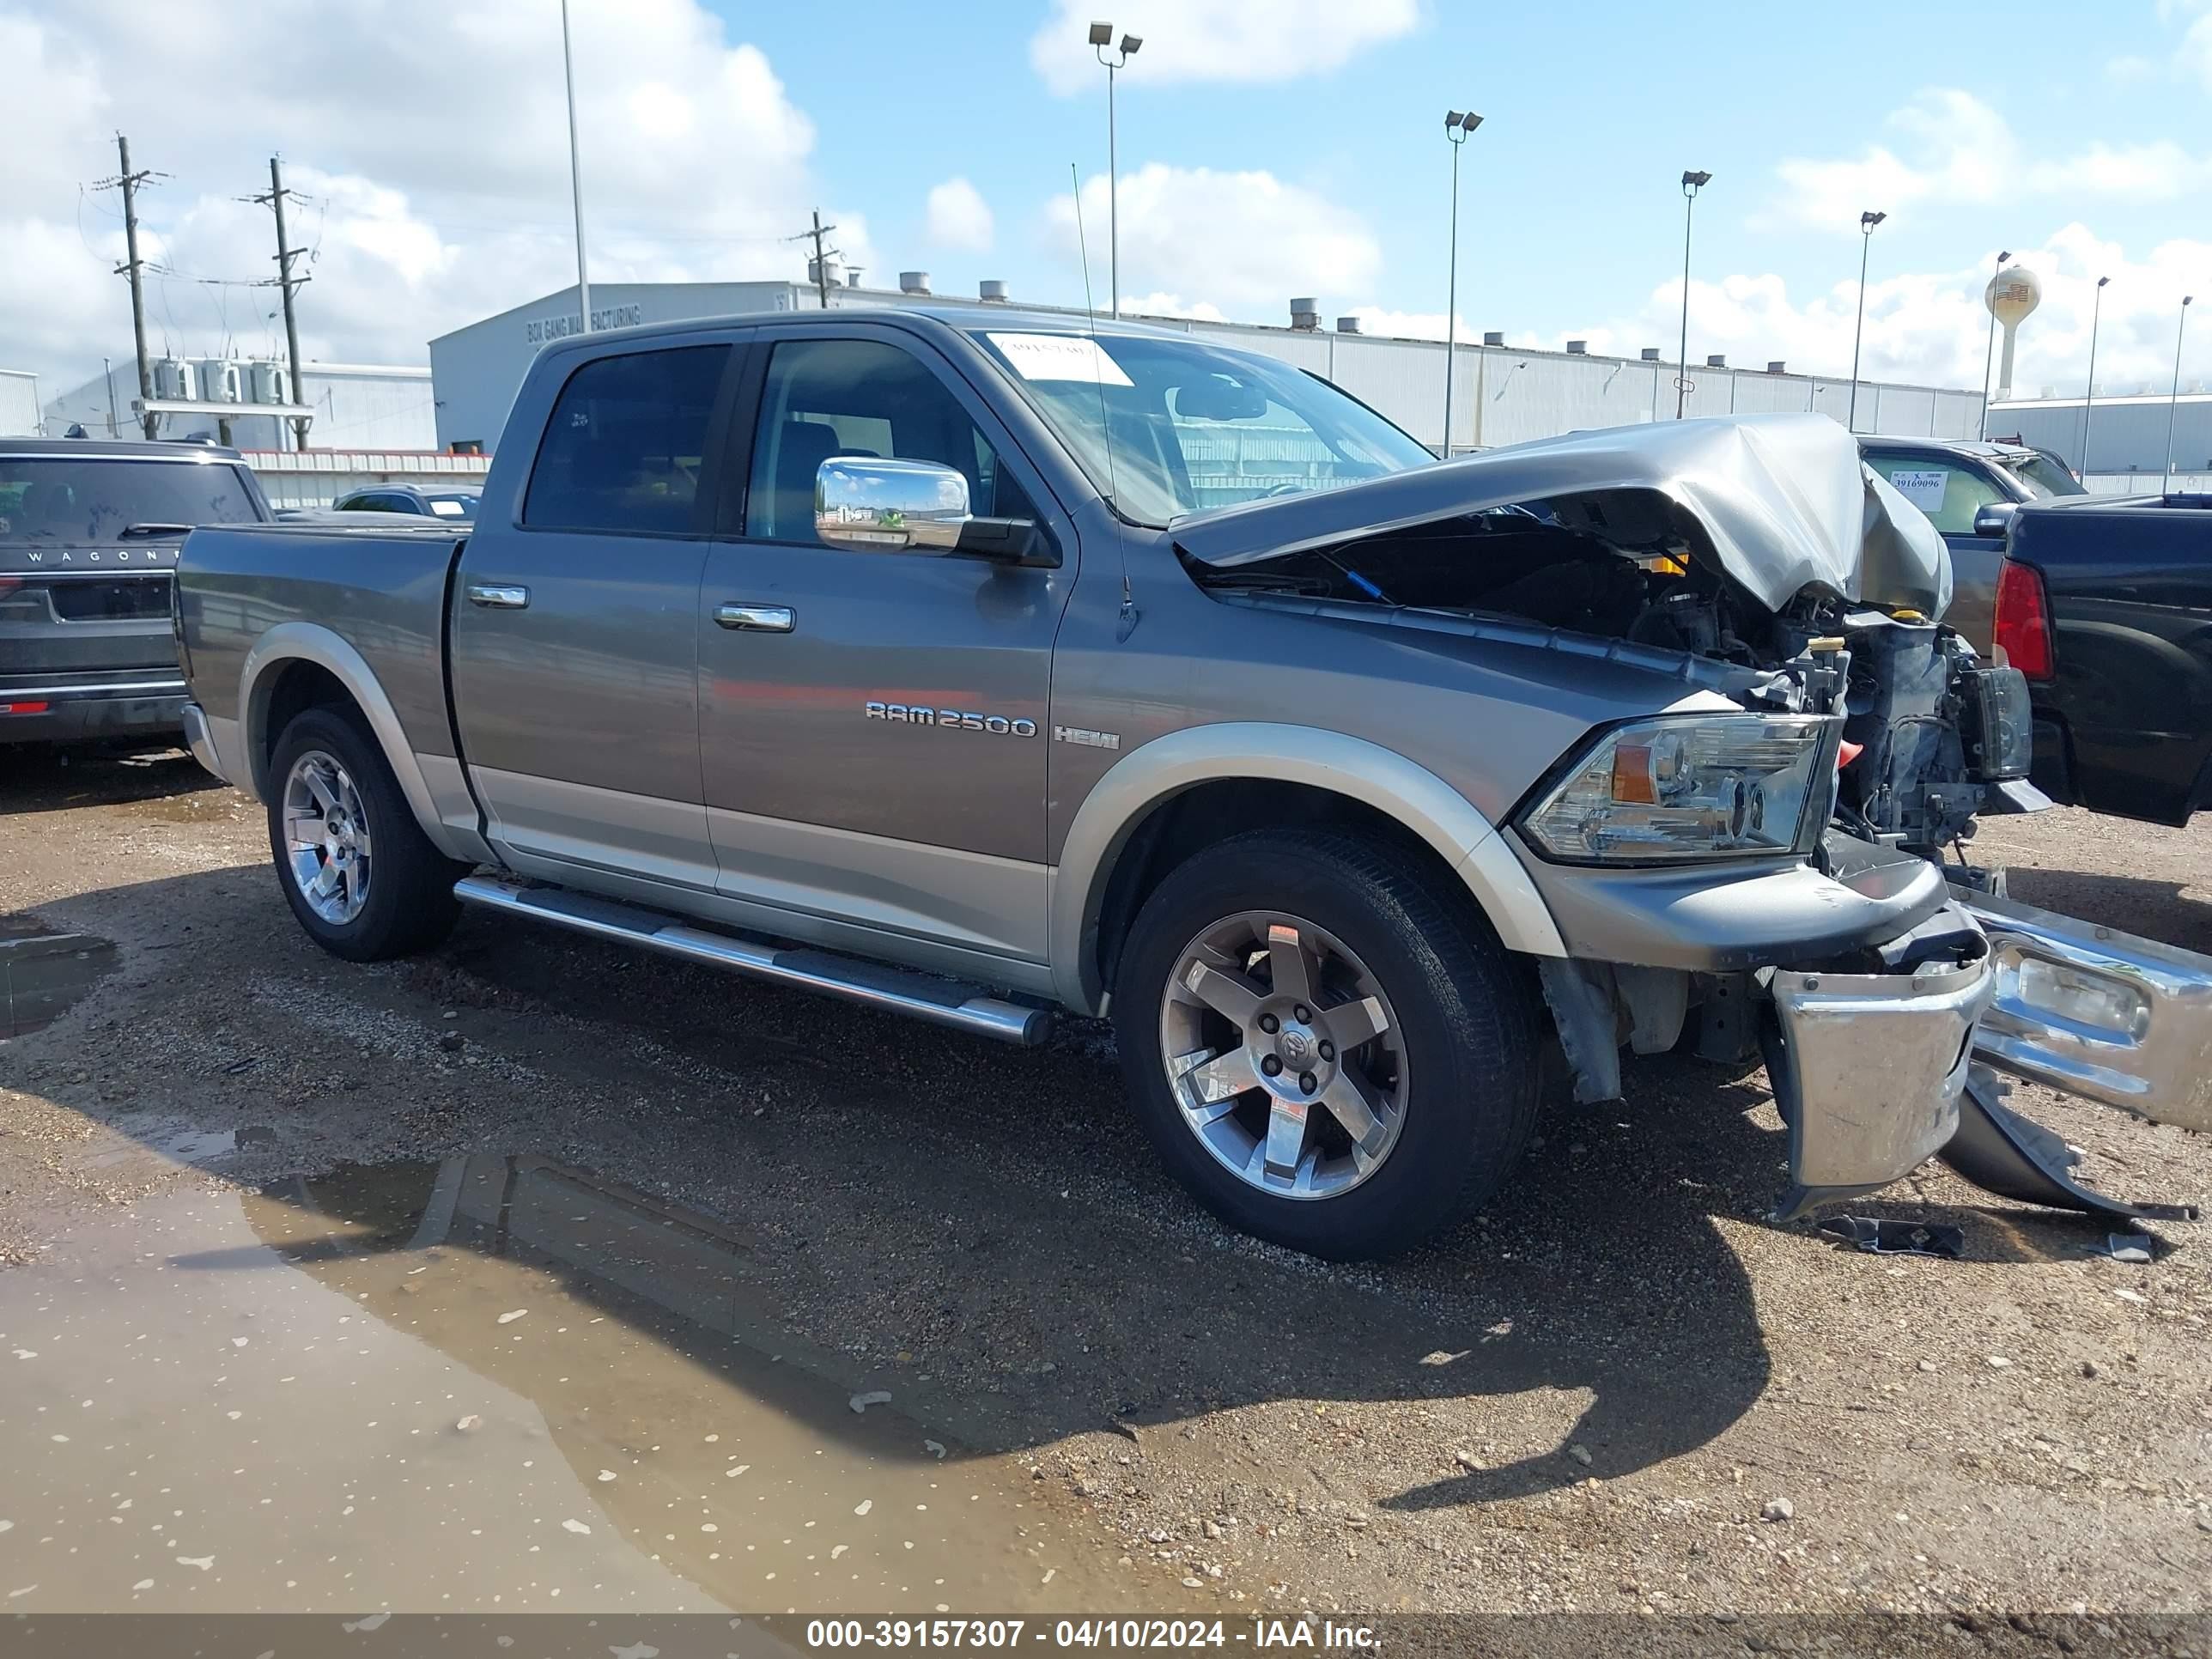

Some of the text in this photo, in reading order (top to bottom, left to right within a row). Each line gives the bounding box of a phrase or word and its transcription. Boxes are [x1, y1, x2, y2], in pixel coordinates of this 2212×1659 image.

[1894, 479, 1939, 488] 39169096
[866, 701, 1038, 738] RAM 2500
[1054, 725, 1121, 750] HEMI
